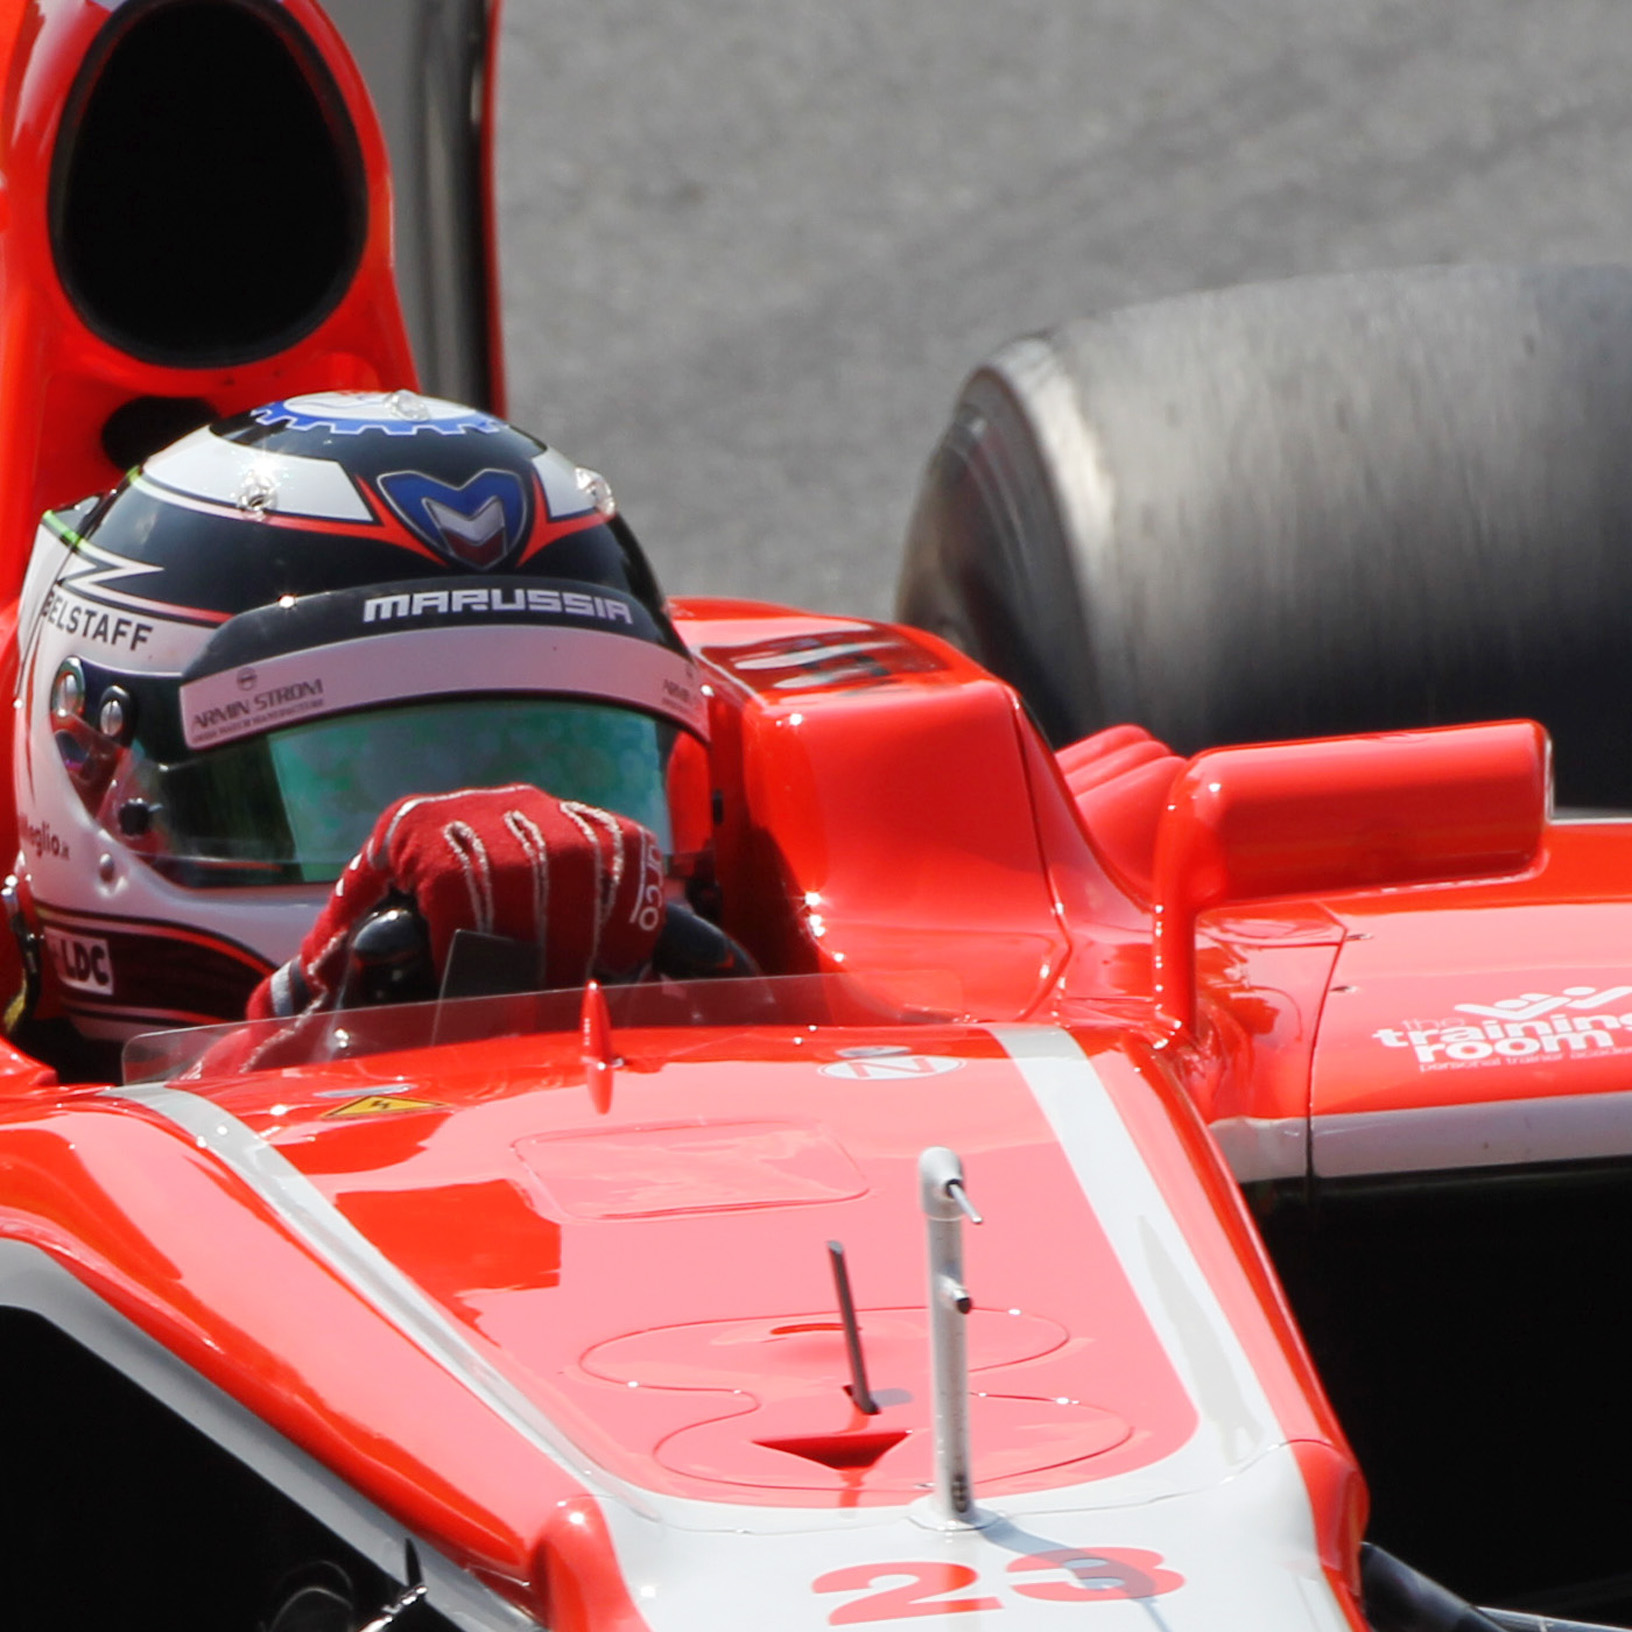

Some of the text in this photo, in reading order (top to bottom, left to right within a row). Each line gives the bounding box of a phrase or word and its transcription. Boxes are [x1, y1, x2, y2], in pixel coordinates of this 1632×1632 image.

[363, 587, 634, 624] MARUSSIA
[193, 699, 250, 728] ARMIN
[254, 678, 324, 711] STROM
[1414, 1030, 1614, 1063] room
[1419, 1056, 1501, 1073] personal
[811, 1545, 1188, 1627] 23
